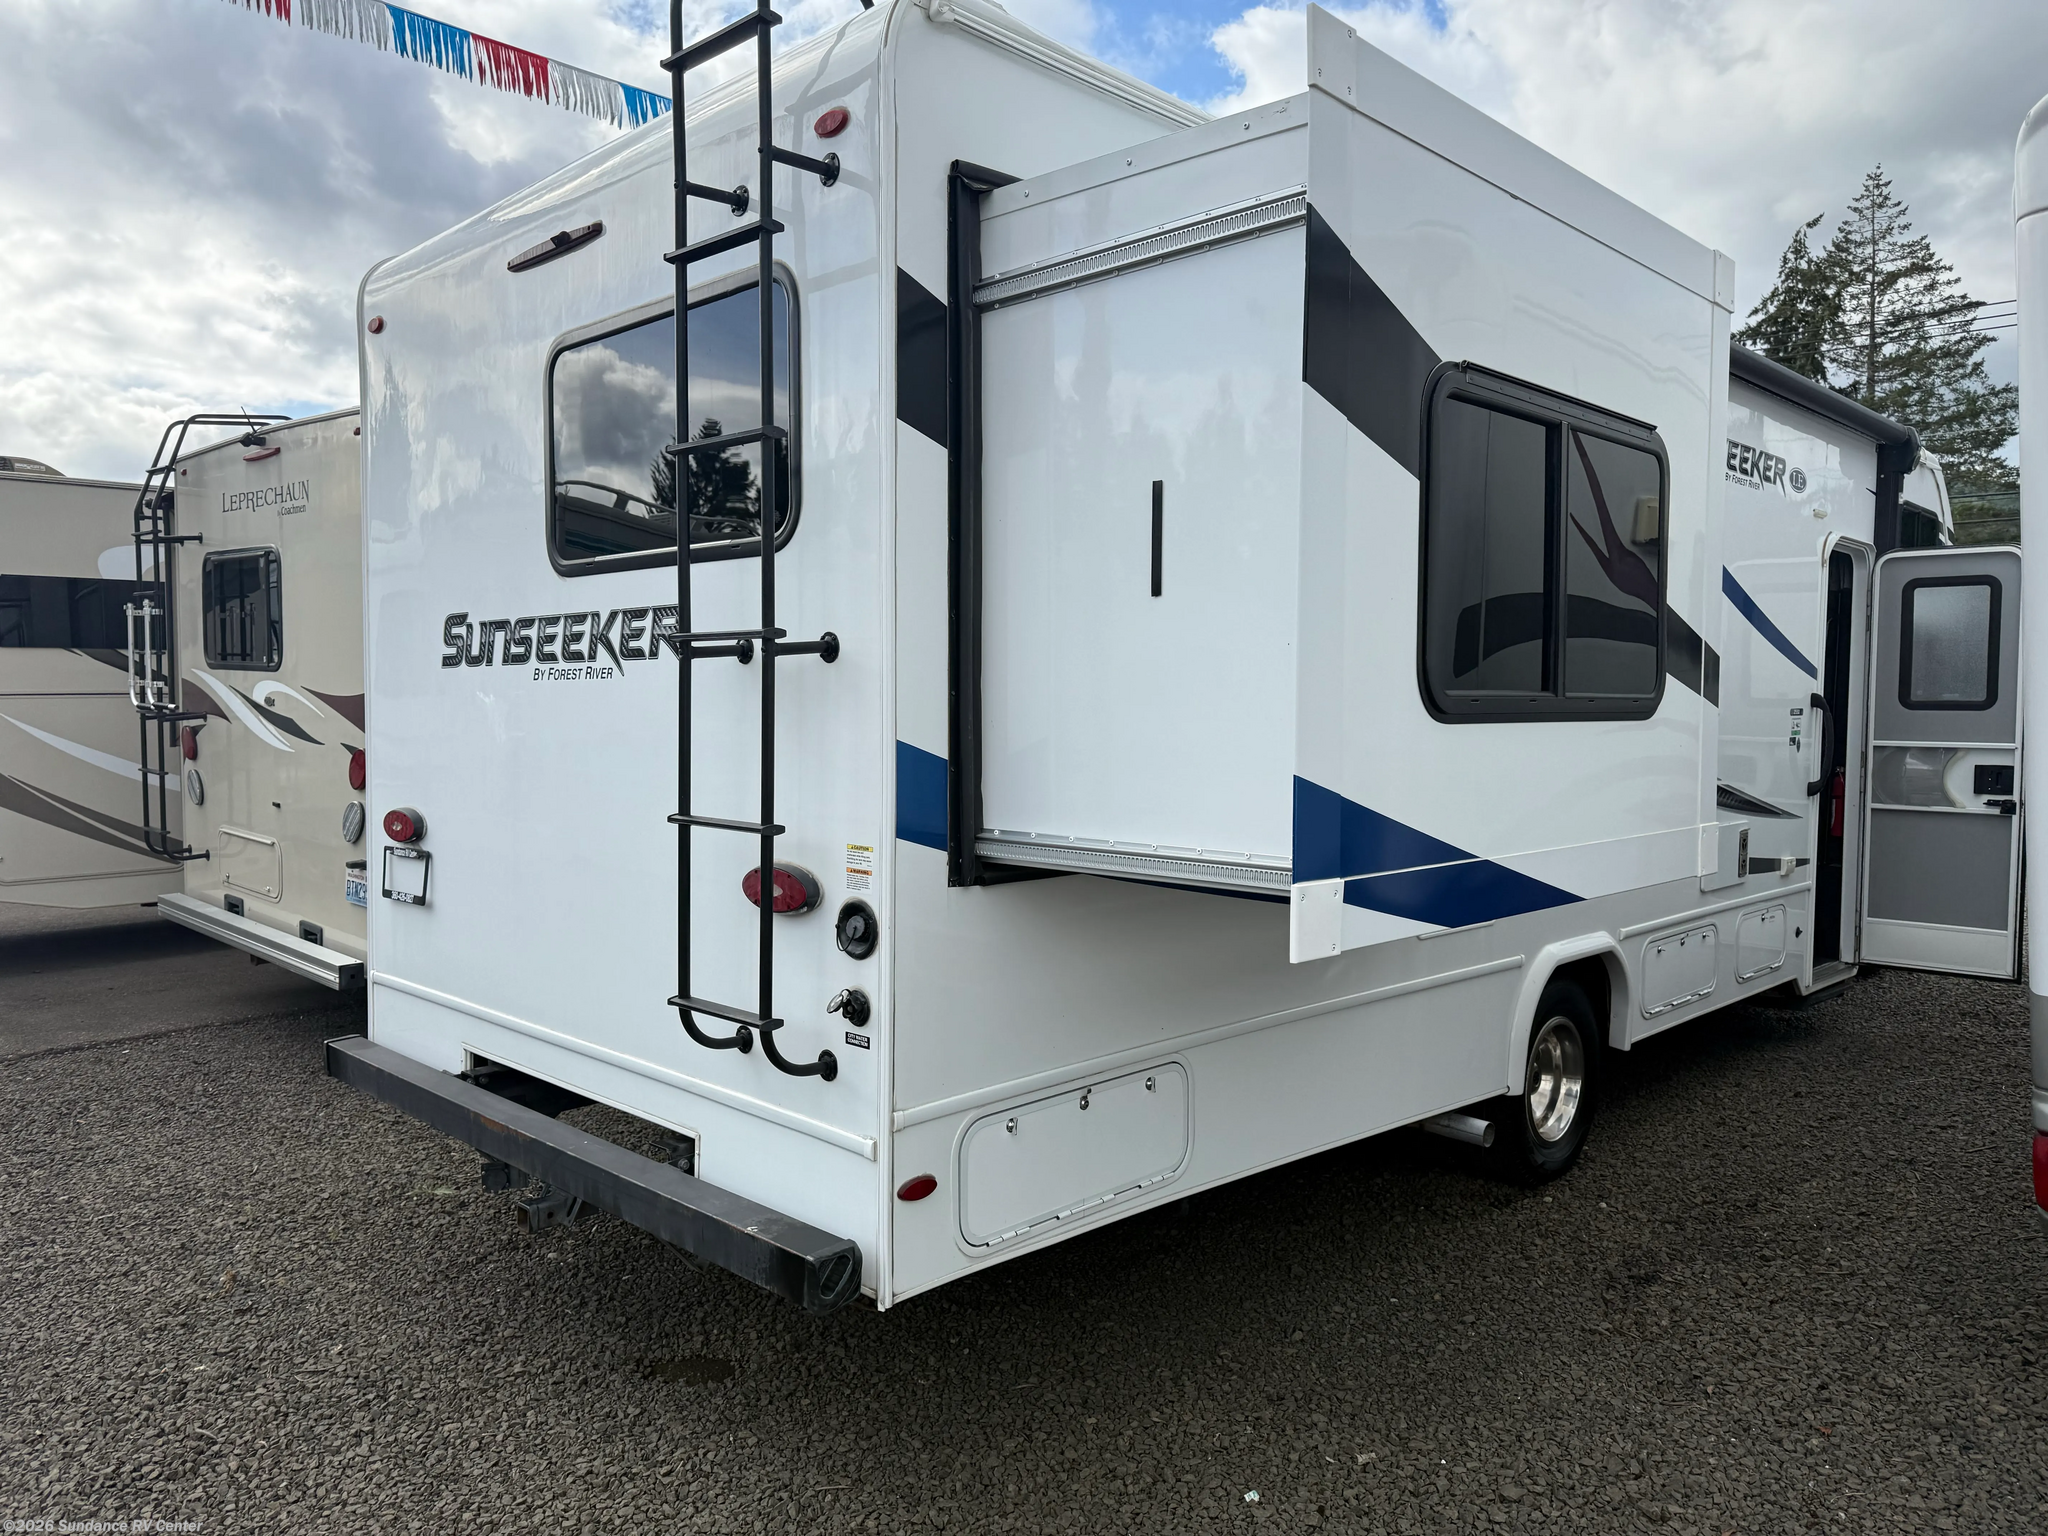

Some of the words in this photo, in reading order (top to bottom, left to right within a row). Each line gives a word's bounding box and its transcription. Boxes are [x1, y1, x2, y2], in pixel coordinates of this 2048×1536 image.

[1726, 437, 1787, 498] EEKER
[1732, 474, 1749, 487] FOREST
[1748, 479, 1761, 491] RIVER
[222, 479, 310, 513] LEPRECHAUN
[281, 504, 306, 516] Coachmen
[548, 667, 583, 680] FOREST
[585, 666, 614, 680] RIVER
